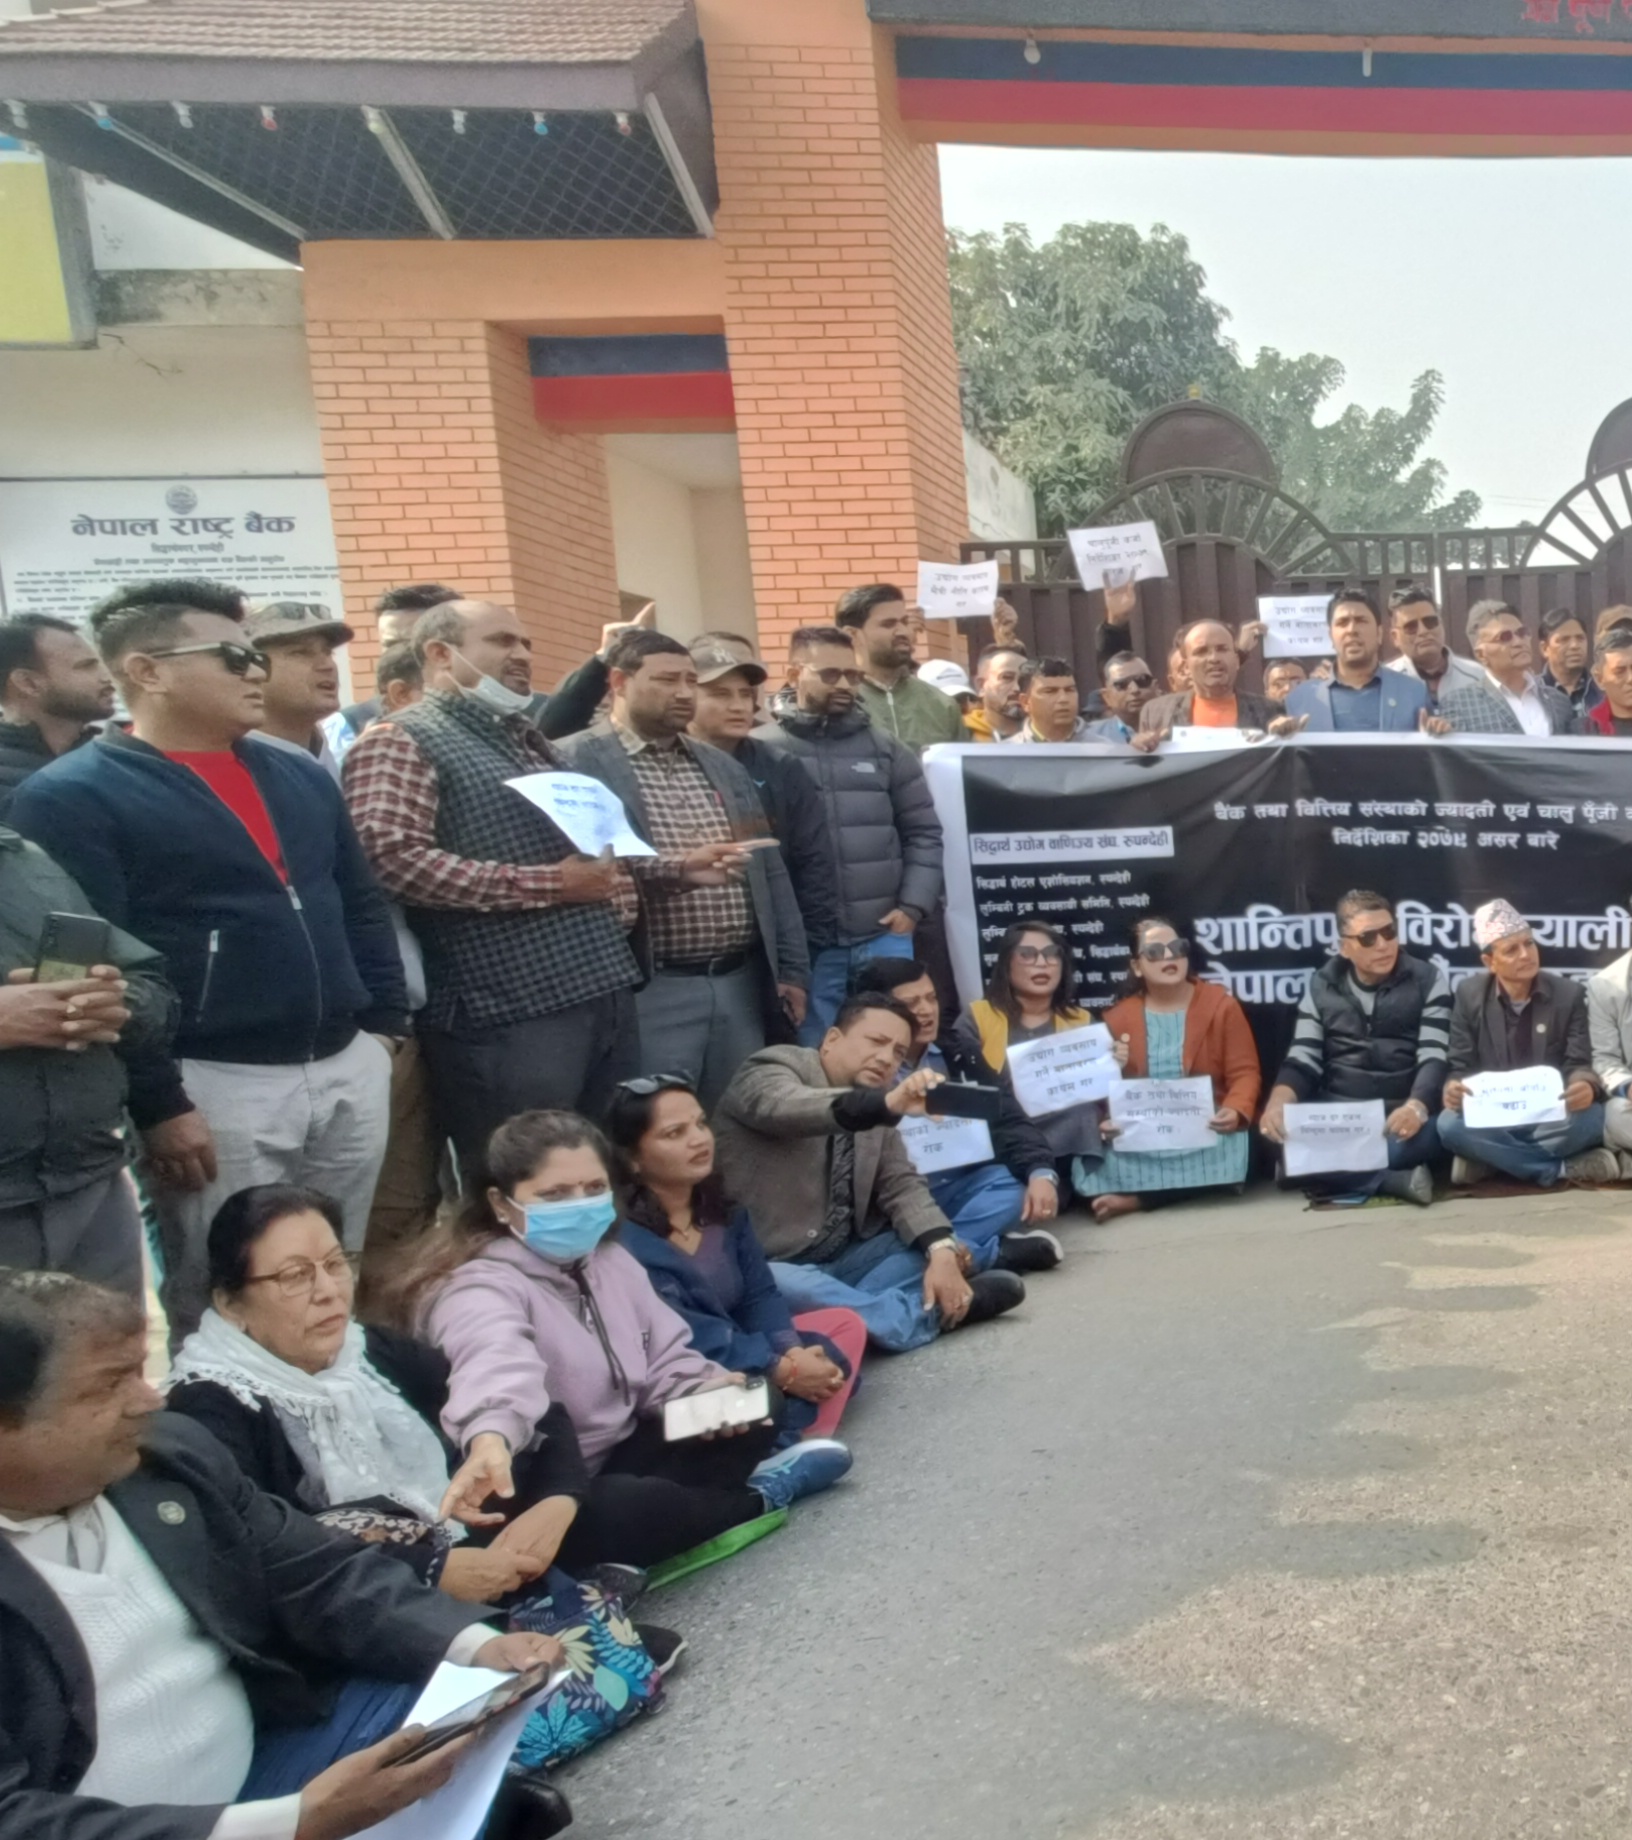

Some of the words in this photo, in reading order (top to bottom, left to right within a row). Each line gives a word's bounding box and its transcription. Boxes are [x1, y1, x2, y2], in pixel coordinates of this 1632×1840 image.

[71, 514, 159, 536] नेपाल
[170, 517, 234, 538] राष्ट्र
[244, 511, 296, 533] बैंक
[1213, 801, 1247, 820] बैंक
[1253, 803, 1289, 819] तथा
[1358, 799, 1428, 818] संस्थाको
[1434, 799, 1496, 819] ज्यादती
[1503, 802, 1531, 821] एवं
[1537, 804, 1576, 823] चालु
[1015, 835, 1045, 851] उद्योग
[1050, 833, 1093, 850] वाणिज्य
[1332, 826, 1411, 847] निर्देशिका
[1477, 832, 1521, 849] असर
[1527, 830, 1560, 850] बारे
